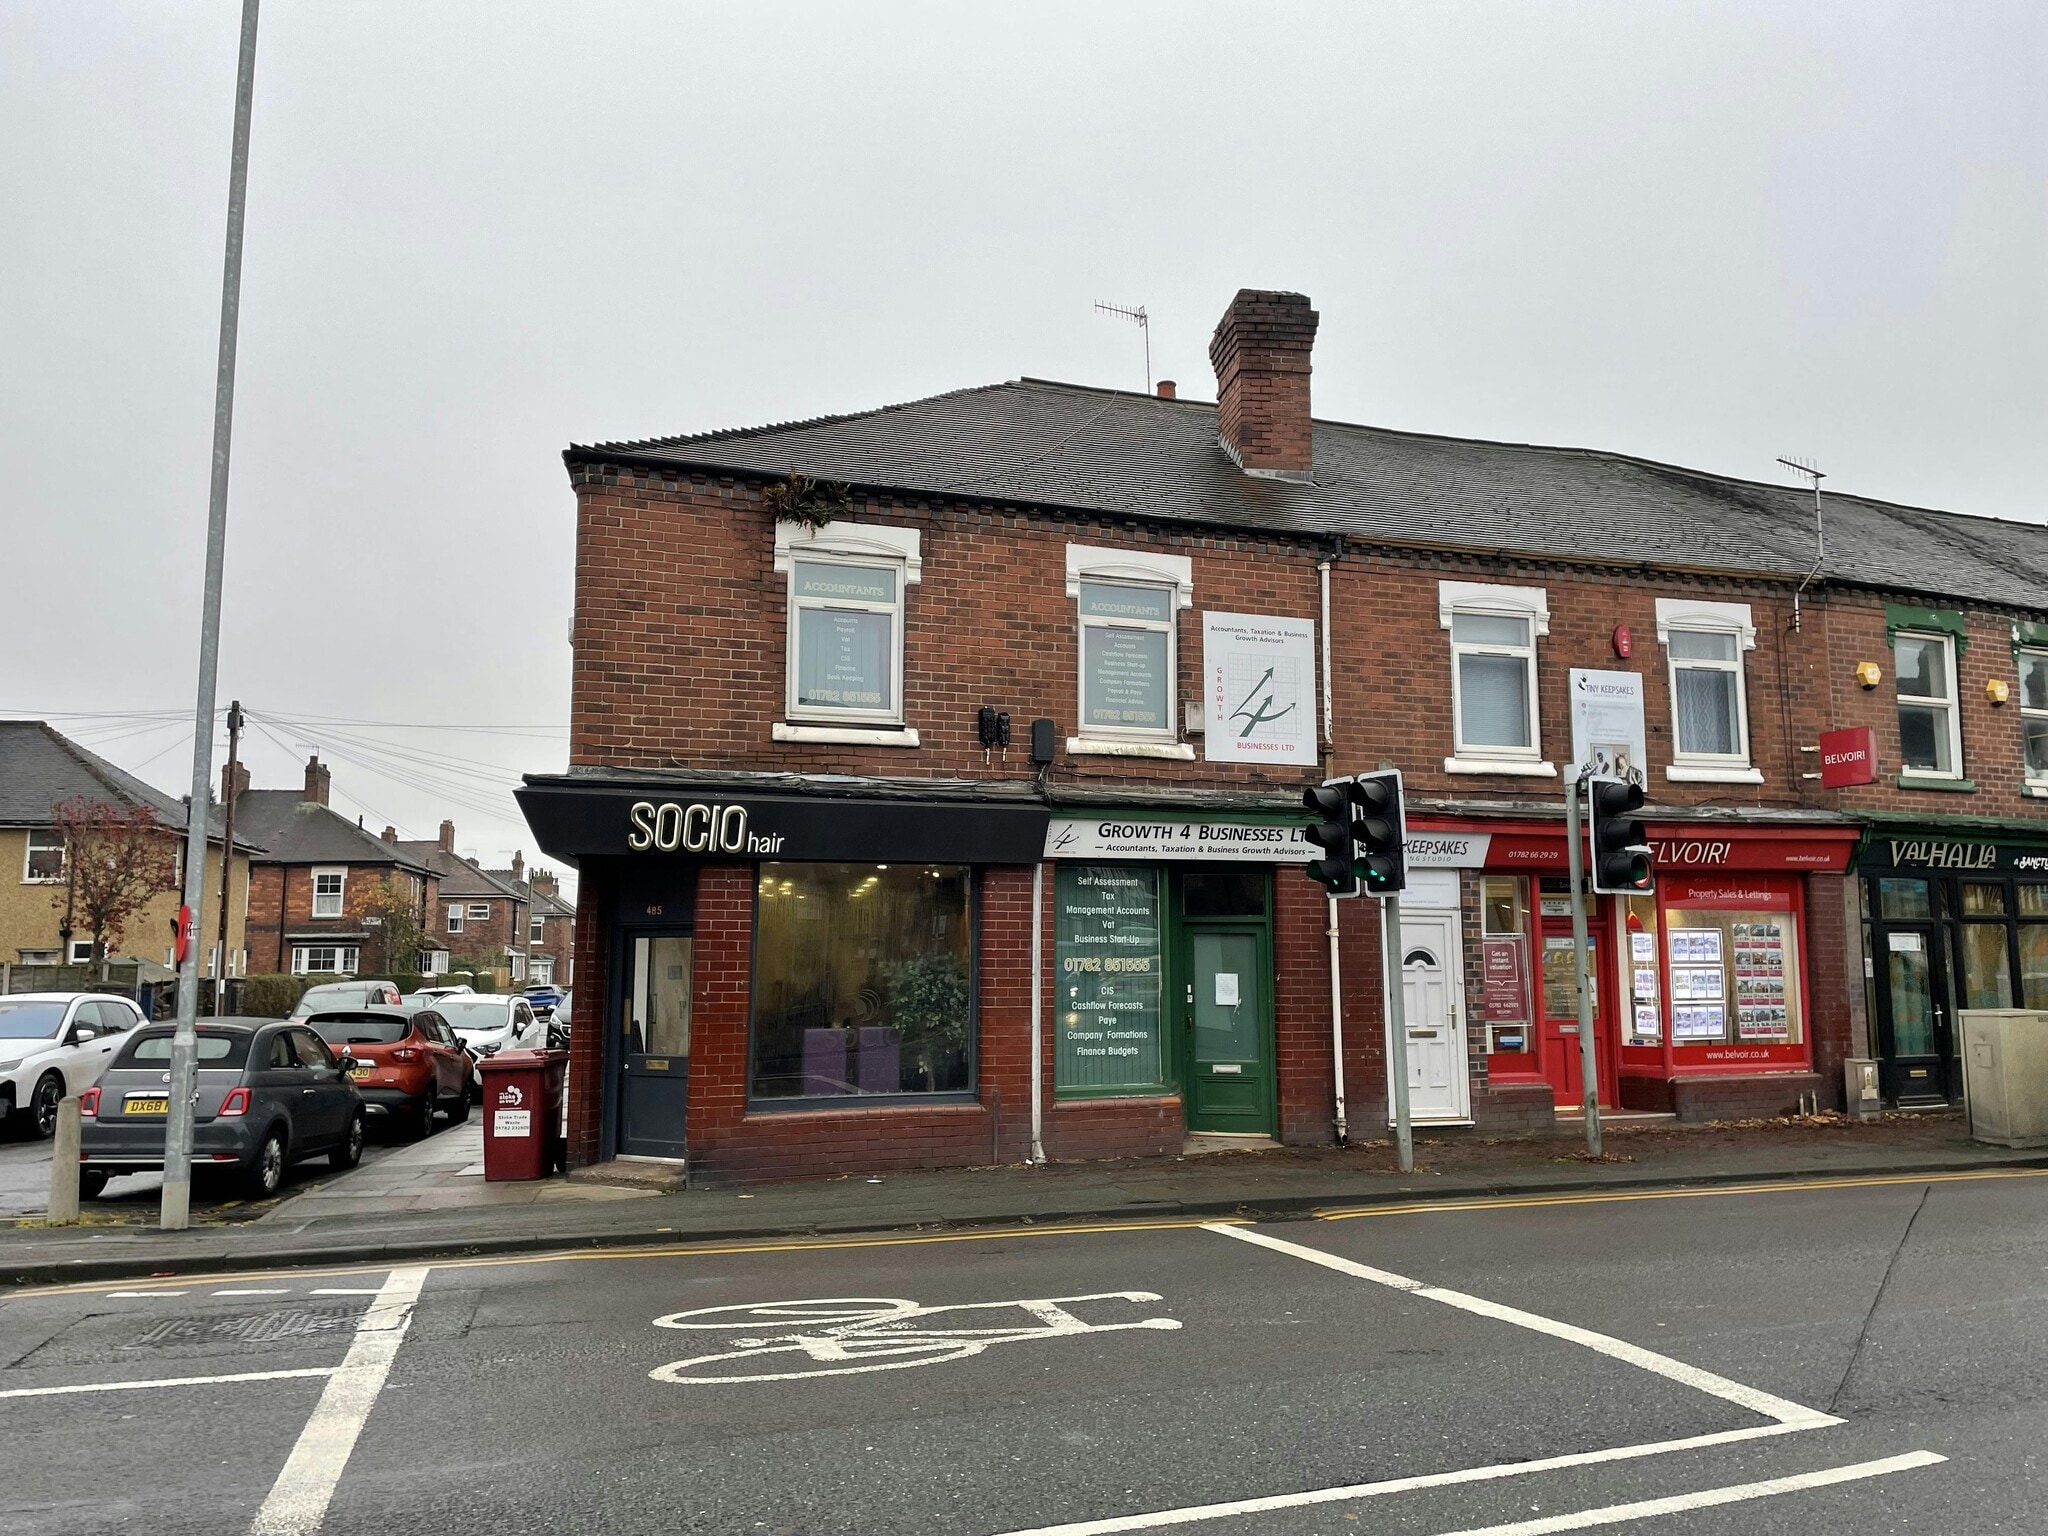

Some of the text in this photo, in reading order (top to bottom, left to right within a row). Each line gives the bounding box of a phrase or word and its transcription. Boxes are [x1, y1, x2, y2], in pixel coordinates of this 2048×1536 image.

[804, 581, 884, 596] ACCOUNTANTS
[1091, 602, 1160, 616] ACCOUNTANTS
[834, 616, 858, 624] Accounts
[837, 626, 855, 634] Payroll
[1210, 625, 1249, 634] Accountants,
[1251, 628, 1275, 636] Taxation
[1116, 633, 1145, 641] Assessment
[1259, 636, 1284, 644] Advisors
[1102, 650, 1148, 659] Cashflow Forecasts
[842, 674, 864, 682] Keeping
[1098, 668, 1152, 678] Management Accounts
[1099, 678, 1150, 687] Company Formations
[808, 689, 839, 701] 01782
[1107, 687, 1124, 695] Payroll
[1216, 667, 1224, 721] GROWTH
[1586, 685, 1634, 695] TINY KEEPSAKES
[1093, 709, 1120, 720] 01782
[1237, 742, 1294, 752] BUSINESSES LTD
[1825, 750, 1866, 765] BELVOIR!
[628, 802, 785, 854] SOCIO hair
[1098, 822, 1306, 842] GROWTH 4 BUSINESSES LT
[1105, 844, 1306, 856] Accountants, Taxation & Business Growth Advisors
[1406, 839, 1469, 855] KEEPSAKES
[1508, 850, 1529, 858] 01782
[1539, 851, 1548, 859] 29
[1890, 840, 1997, 869] VALHALLA
[1078, 877, 1138, 886] Self Assessment
[1101, 892, 1115, 900] Tax
[1688, 889, 1772, 900] Property Sales & Lettings
[646, 905, 662, 915] 485
[1066, 905, 1150, 915] Management Accounts
[1102, 920, 1115, 928] Vat
[1074, 934, 1140, 944] Business Start-Up
[1064, 958, 1150, 972] 01782 851555
[1101, 986, 1114, 995] CIS
[1071, 1001, 1143, 1009] Cashflow Forecasts
[1098, 1016, 1117, 1025] Paye
[1067, 1030, 1148, 1041] Company Formations
[1077, 1046, 1139, 1056] Finance Budgets
[1706, 1049, 1770, 1059] www.belvoir.co.uk
[131, 1101, 162, 1111] DX68
